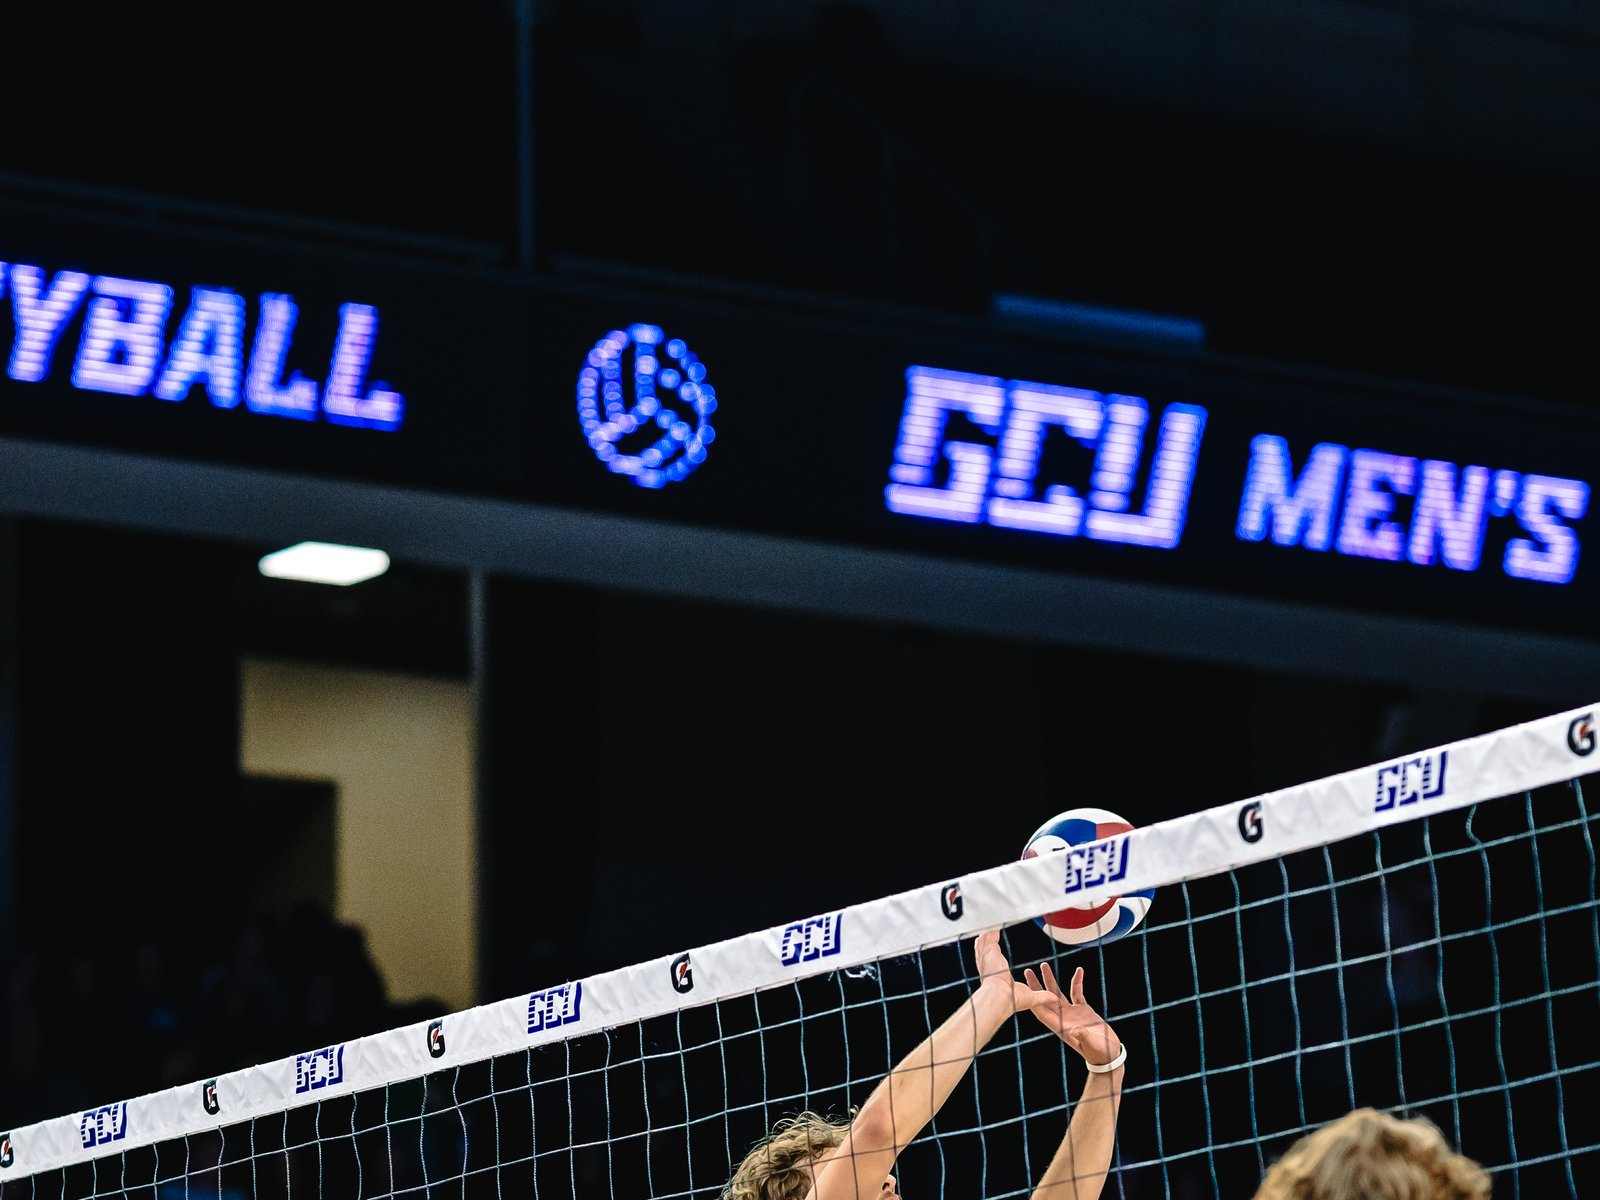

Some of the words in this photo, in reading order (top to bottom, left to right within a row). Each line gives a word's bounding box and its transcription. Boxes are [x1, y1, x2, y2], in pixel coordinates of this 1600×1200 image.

[0, 261, 404, 432] YBALL
[885, 364, 1208, 549] GCU
[1235, 434, 1590, 584] MEN'S
[80, 1102, 128, 1149] GCU
[202, 1079, 221, 1116] G
[295, 1044, 345, 1095] GCU
[426, 1020, 446, 1059] G
[527, 981, 583, 1034] GCU
[670, 952, 694, 994] G
[781, 913, 843, 967] GCU
[940, 882, 964, 922] G
[1065, 836, 1131, 894] GCU
[1237, 801, 1264, 844] G
[1374, 751, 1449, 813] GCU
[1566, 713, 1596, 757] G
